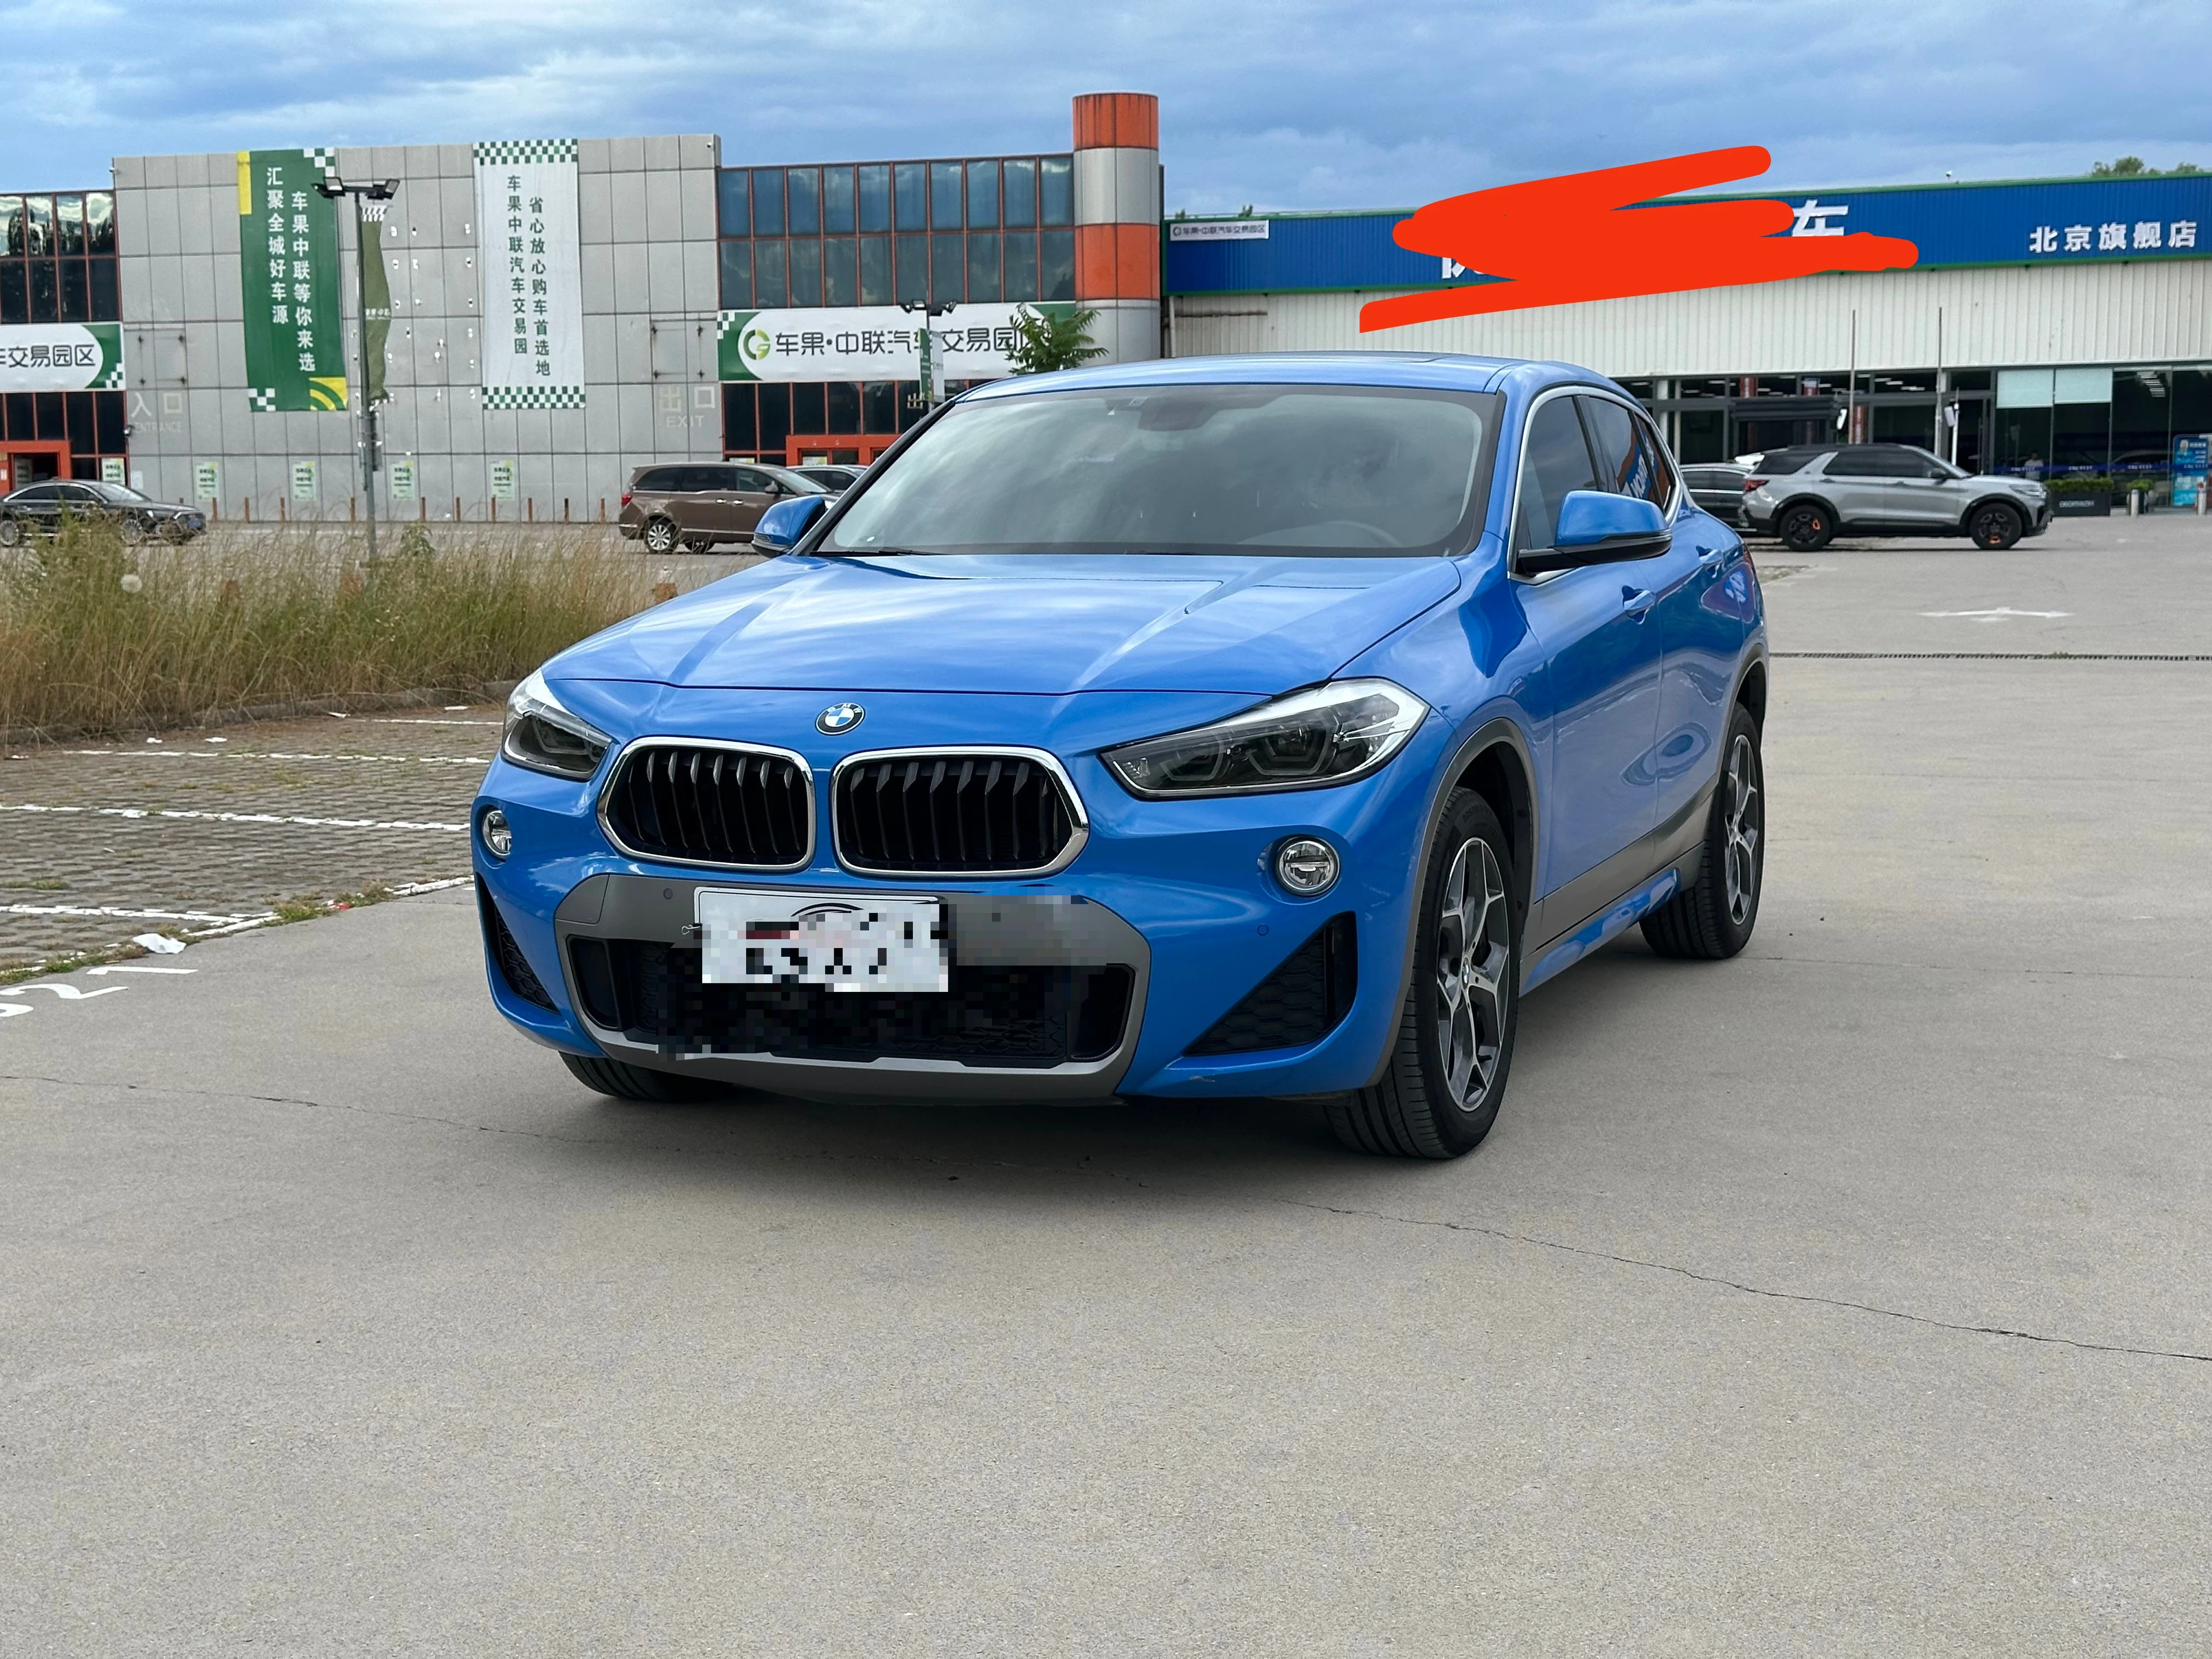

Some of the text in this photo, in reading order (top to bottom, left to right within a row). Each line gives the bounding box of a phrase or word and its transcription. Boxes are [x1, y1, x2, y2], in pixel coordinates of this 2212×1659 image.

[266, 166, 289, 324] 汇聚全城好车源
[291, 191, 316, 372] 车果中联等你来选
[507, 174, 528, 354] 车果中联汽车交易园
[2029, 219, 2197, 253] 北京旗舰店
[529, 196, 551, 376] 省心放心购车首选地
[131, 392, 183, 418] 入口
[659, 385, 715, 412] 出口
[666, 415, 705, 429] EXIT
